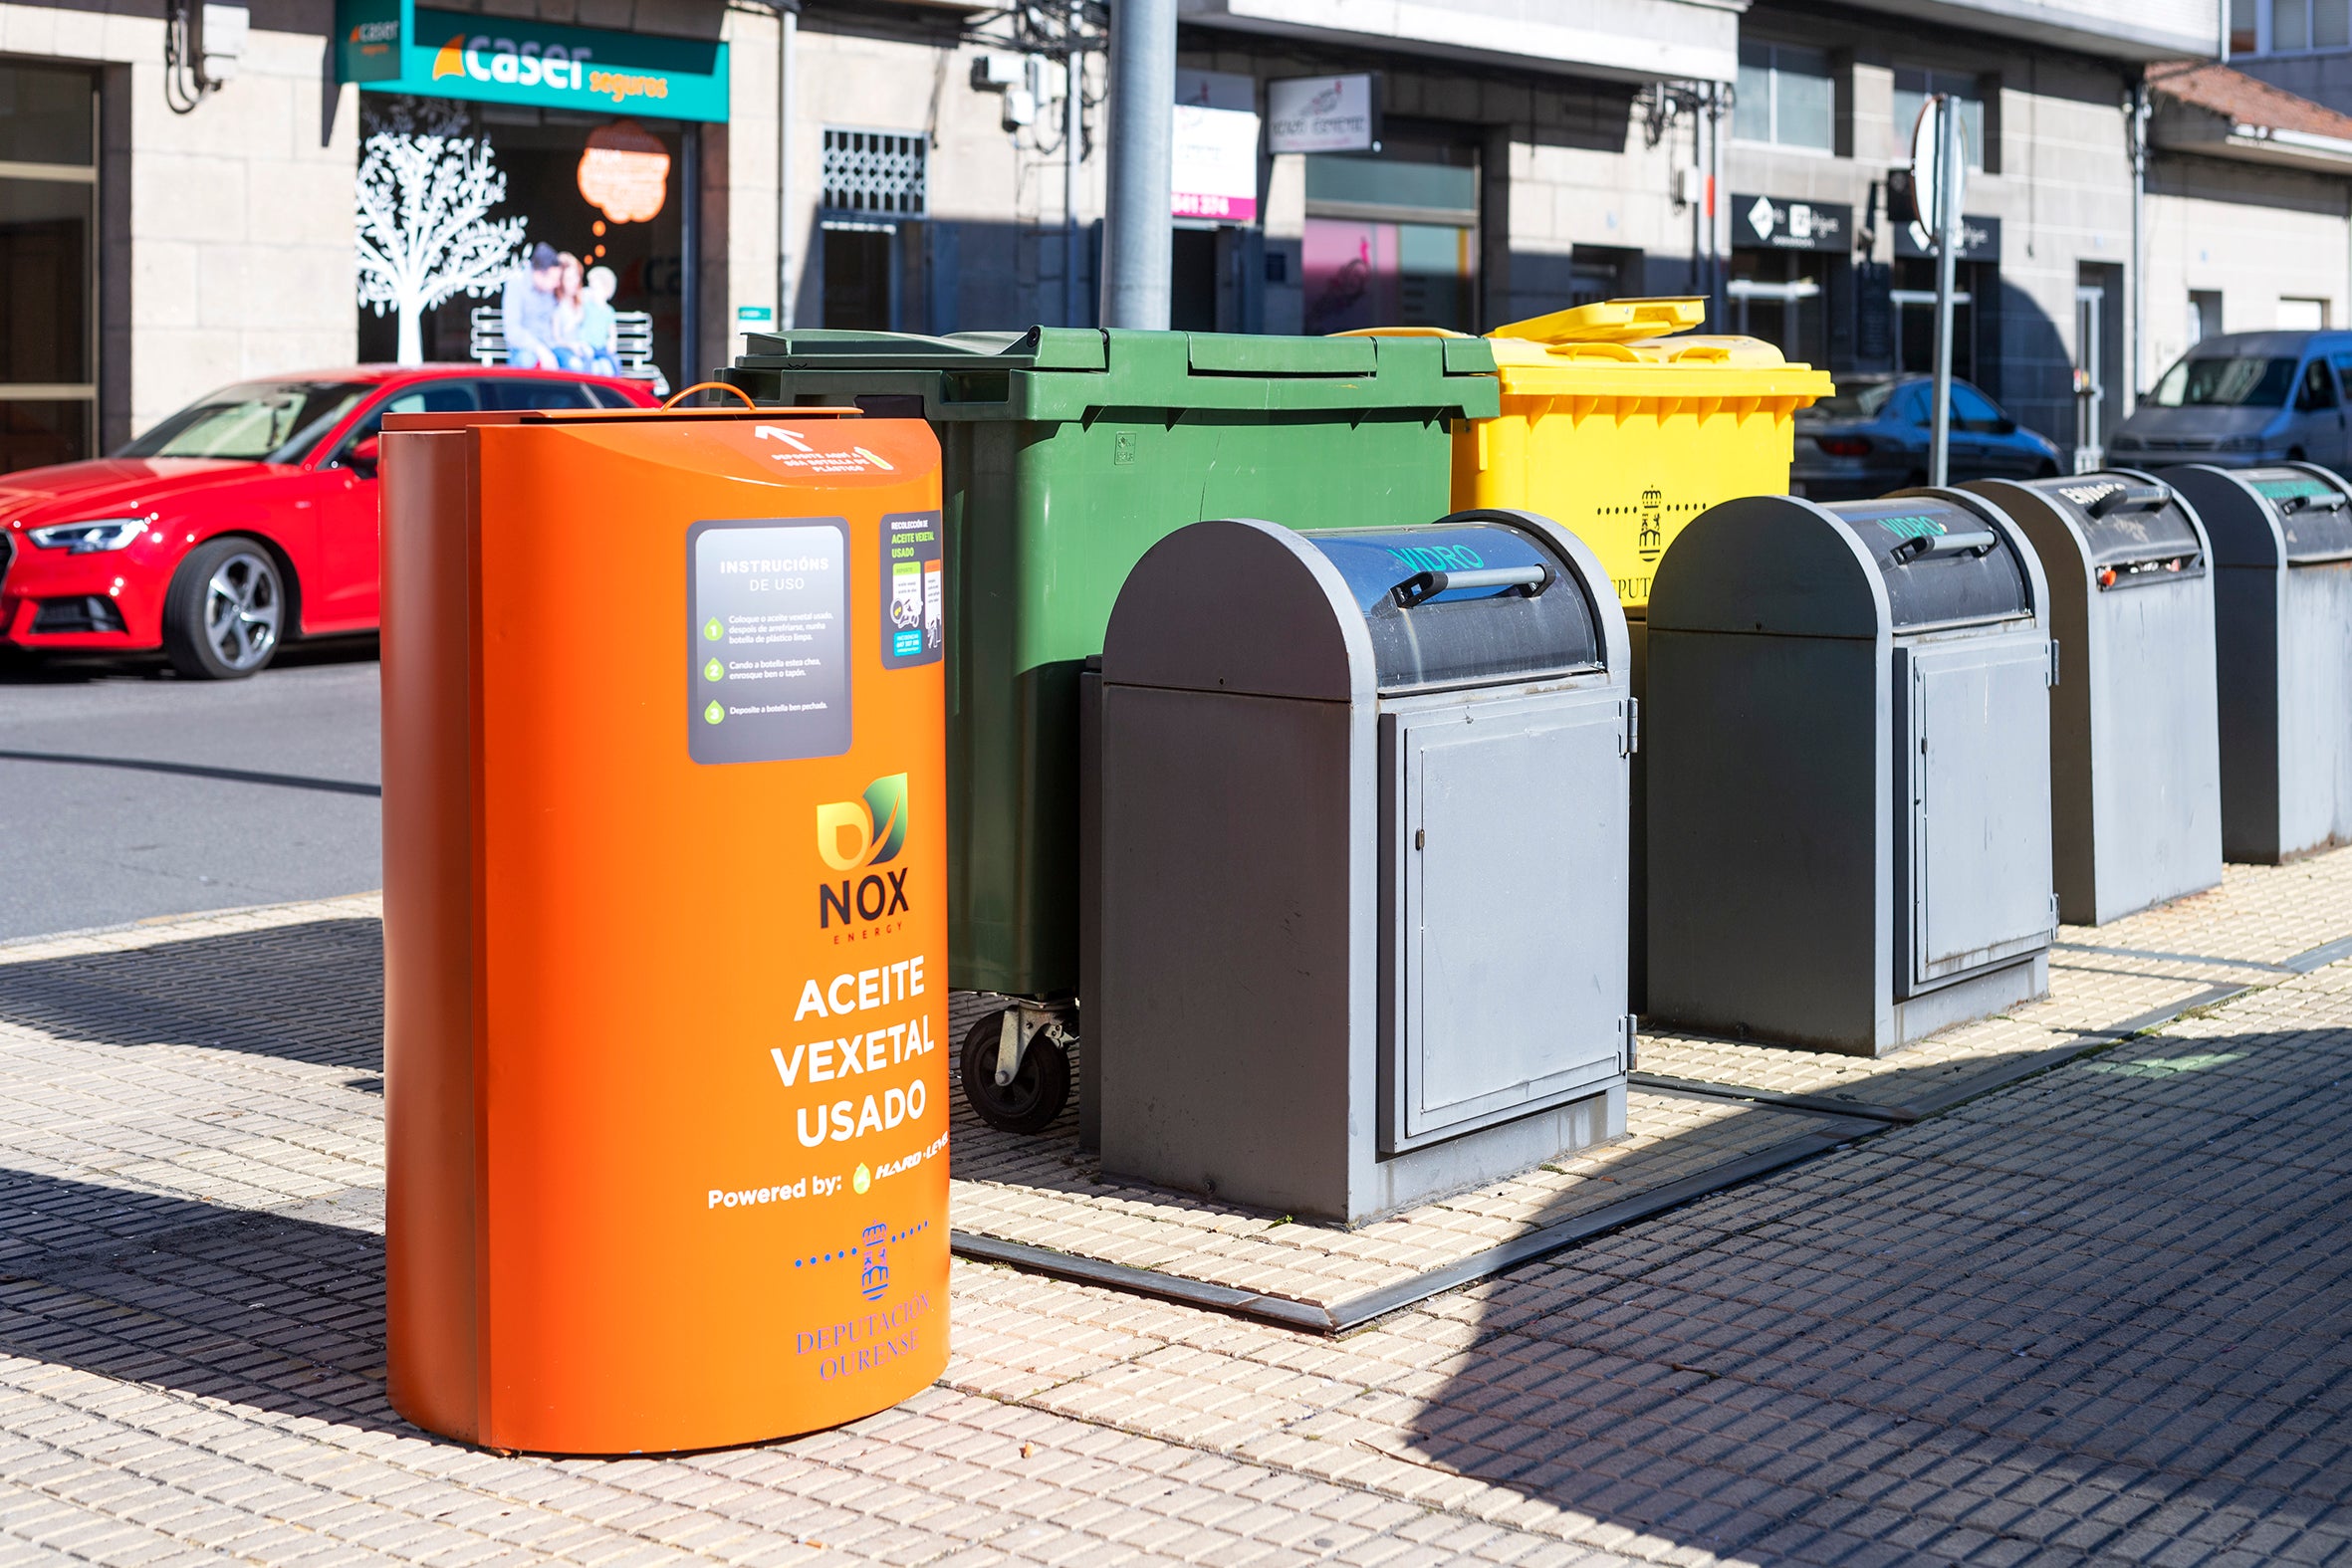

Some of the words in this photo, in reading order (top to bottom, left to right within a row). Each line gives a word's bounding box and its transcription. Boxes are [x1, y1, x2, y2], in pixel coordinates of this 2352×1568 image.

[465, 35, 592, 91] caser
[588, 71, 668, 103] seguros
[1876, 516, 1945, 539] VIDRO
[891, 533, 915, 544] ACEITE
[891, 547, 915, 559] USADO
[1385, 544, 1485, 573] VIDRO
[720, 557, 829, 573] INSTRUCIÓNS
[750, 577, 770, 591] DE
[775, 576, 805, 590] USO
[728, 614, 760, 625] Coloque
[767, 613, 789, 623] aceite
[710, 624, 718, 638] 1
[728, 624, 758, 636] despois
[758, 624, 768, 633] de
[728, 635, 755, 645] botella
[755, 634, 766, 644] de
[710, 664, 720, 678] 2
[728, 661, 754, 670] Cando
[760, 659, 785, 669] botella
[785, 659, 804, 668] estea
[728, 671, 764, 681] enrosque
[764, 669, 779, 679] ben
[710, 708, 720, 721] 3
[729, 705, 761, 716] Deposite
[766, 704, 789, 714] botella
[789, 703, 802, 712] ben
[820, 866, 910, 930] NOX
[833, 921, 903, 945] ENERGY
[794, 955, 925, 1022] ACEITE
[770, 1013, 935, 1087] VEXETAL
[797, 1078, 927, 1148] USADO
[708, 1178, 807, 1210] Powered
[812, 1175, 843, 1198] by:
[797, 1289, 931, 1356] DEPUTACIÓN
[820, 1326, 919, 1382] OURENSE
